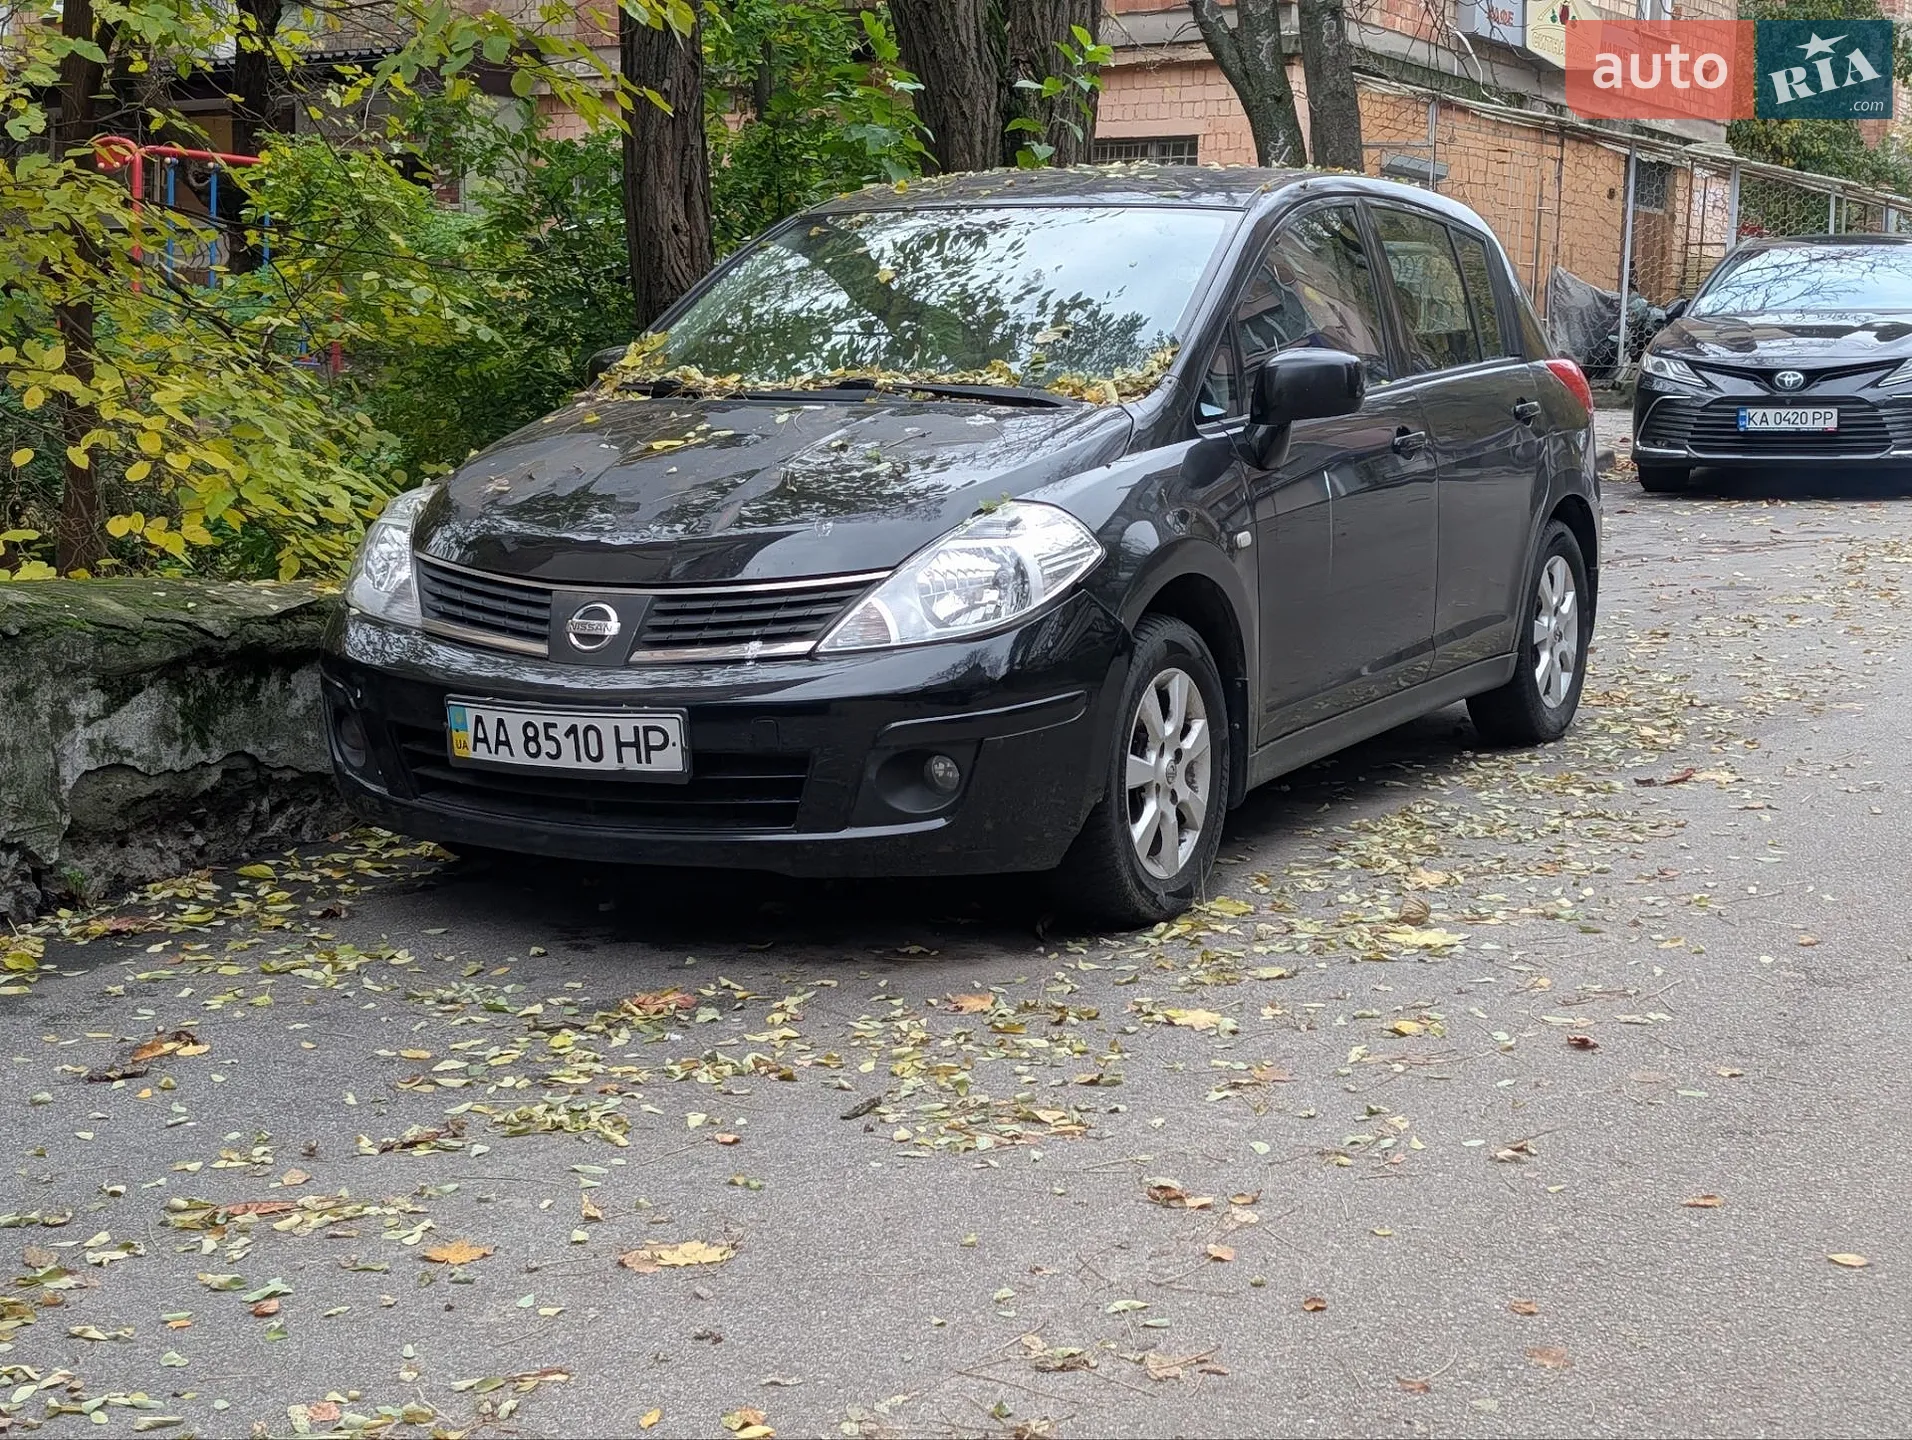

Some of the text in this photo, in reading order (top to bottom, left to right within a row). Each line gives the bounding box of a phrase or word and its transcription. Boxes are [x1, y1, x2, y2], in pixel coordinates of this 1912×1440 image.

[1747, 411, 1769, 426] KA
[1773, 411, 1809, 426] 0420
[1812, 411, 1834, 425] PP
[570, 621, 613, 632] NISSAN
[455, 739, 469, 751] UA
[472, 714, 670, 765] AA 8510 HP
